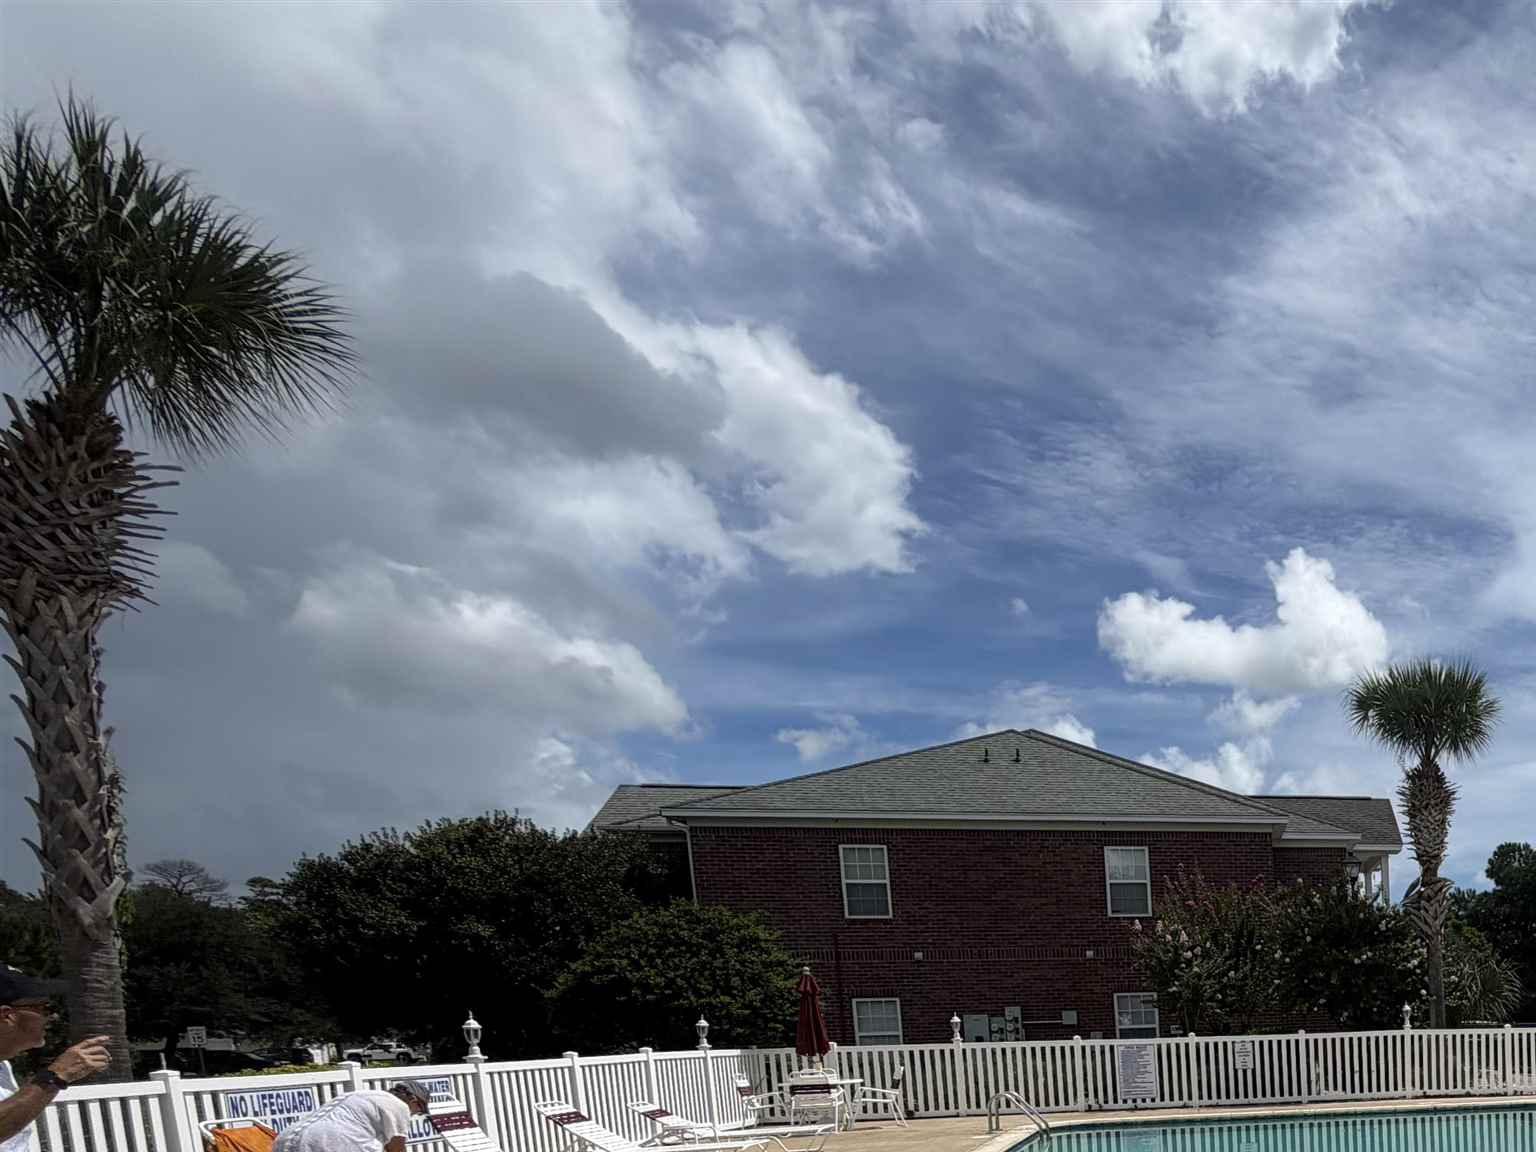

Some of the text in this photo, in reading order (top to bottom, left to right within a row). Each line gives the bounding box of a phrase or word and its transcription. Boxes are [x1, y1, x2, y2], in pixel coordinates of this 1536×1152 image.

[230, 1090, 313, 1118] NO LIFEGUARD
[271, 1116, 300, 1135] DUT
